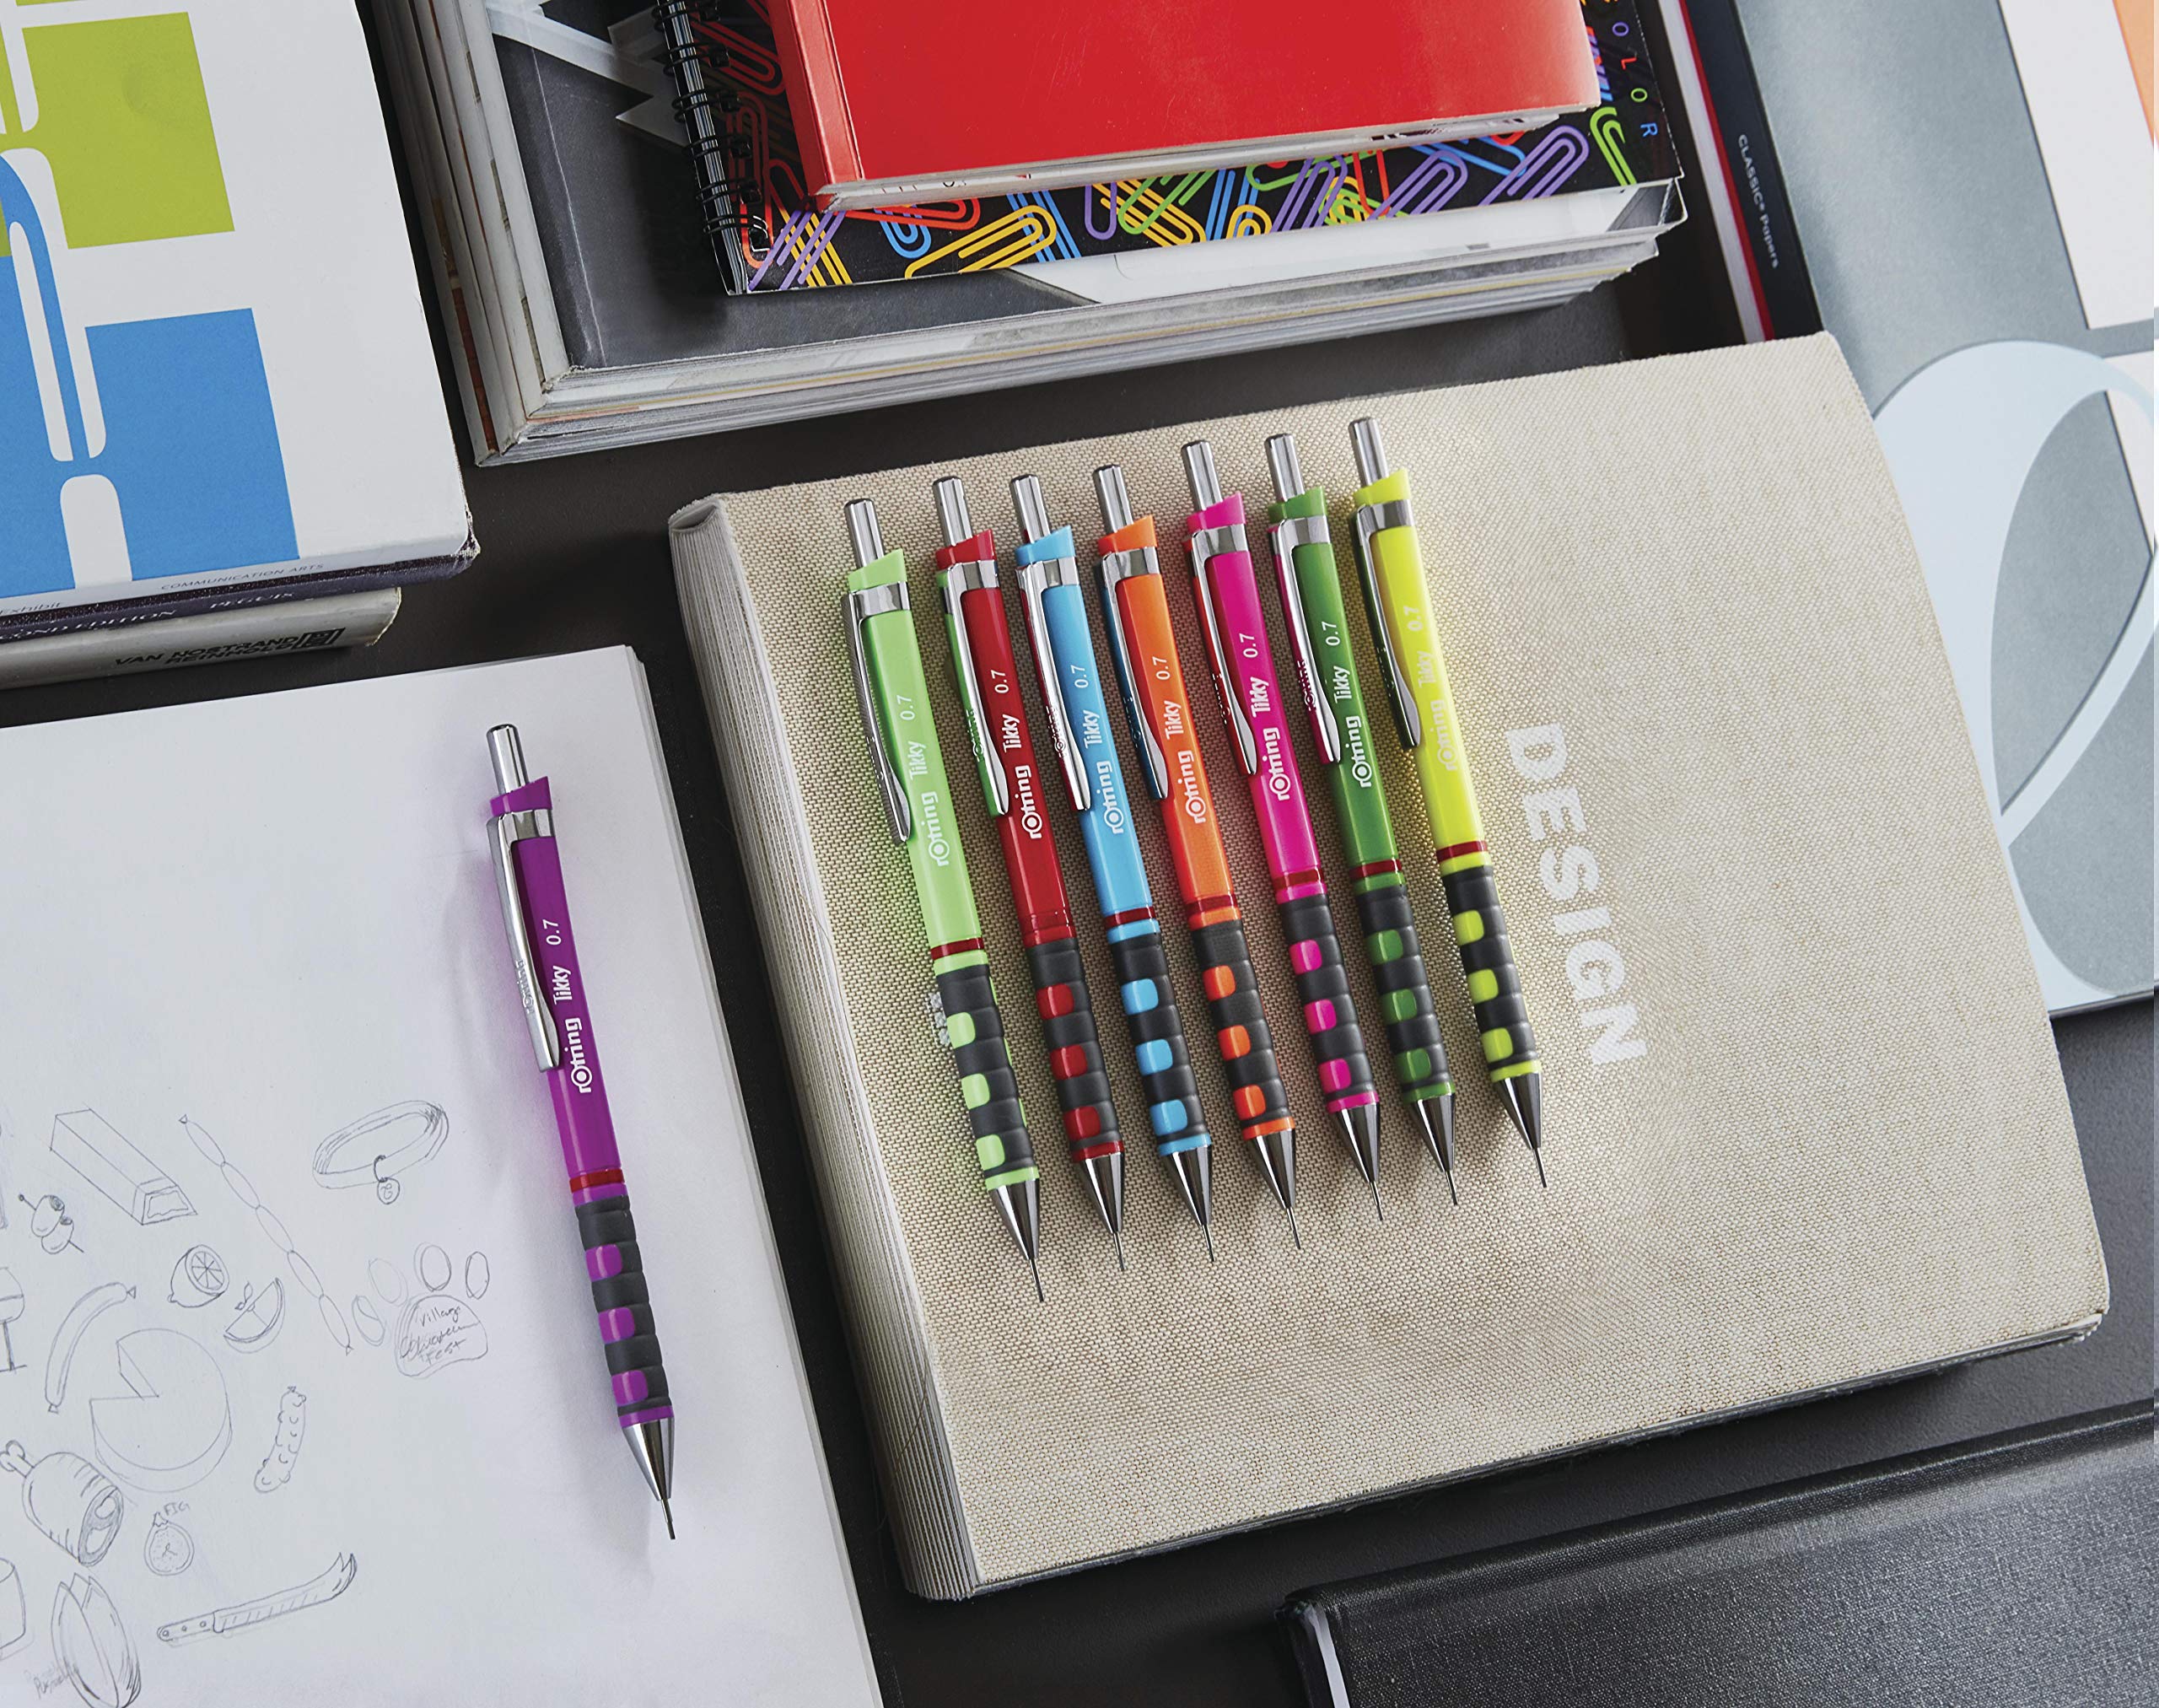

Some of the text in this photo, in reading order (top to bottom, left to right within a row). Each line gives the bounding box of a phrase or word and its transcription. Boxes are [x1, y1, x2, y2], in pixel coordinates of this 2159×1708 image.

[1605, 0, 1658, 137] OLOR
[1759, 213, 1779, 268] Papers
[161, 563, 324, 590] COMMUNICATION ARTS
[75, 609, 176, 631] EDITION
[1322, 622, 1340, 646] 0.7
[1403, 606, 1423, 632] 0.7
[115, 636, 299, 665] VAN NOSTRAND
[1239, 633, 1258, 658] 0.7
[991, 670, 1009, 693] 0.7
[1070, 665, 1089, 688] 0.7
[1152, 656, 1170, 681] 0.7
[1332, 665, 1352, 703] Tikky
[1417, 650, 1436, 688] Tikky
[896, 694, 915, 720] 0.7
[1250, 676, 1270, 718] Tikky
[1003, 714, 1021, 752] Tikky
[1083, 710, 1102, 749] Tikky
[1164, 700, 1183, 740] Tikky
[908, 741, 928, 780] Tikky
[1505, 722, 1648, 1065] DESIGN
[542, 919, 562, 945] 0.7
[552, 966, 573, 1005] Tikky
